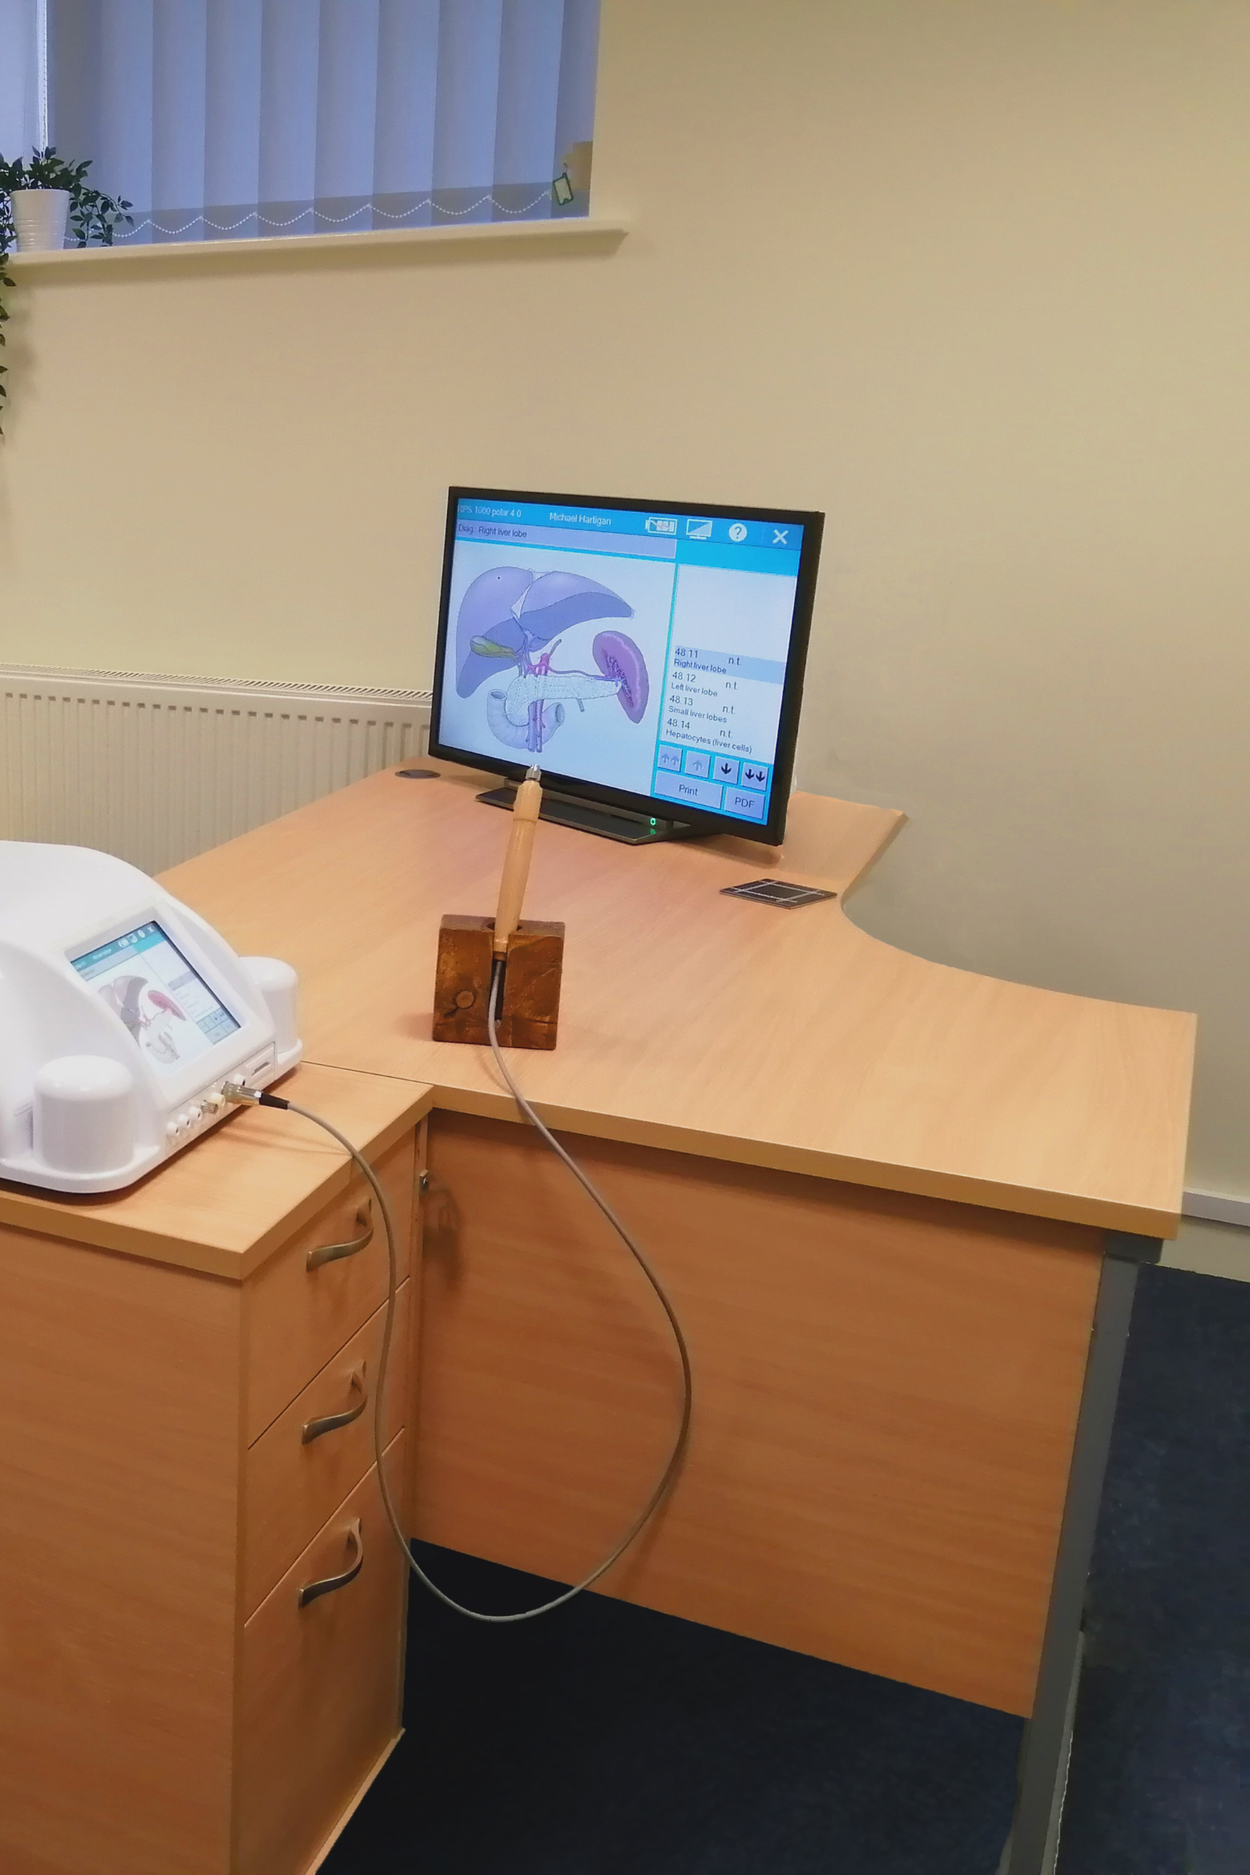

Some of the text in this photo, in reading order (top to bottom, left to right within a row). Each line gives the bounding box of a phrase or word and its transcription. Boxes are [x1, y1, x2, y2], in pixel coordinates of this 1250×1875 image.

[474, 506, 491, 516] 1000
[491, 508, 509, 517] polar
[549, 512, 612, 528] Michael Hartigan
[478, 526, 497, 537] Right
[497, 527, 511, 536] liver
[511, 528, 528, 538] lobe
[673, 658, 727, 674] Right liver lobe
[671, 682, 718, 698] Left liver lobe
[669, 695, 694, 706] 48.13
[668, 705, 728, 723] Small liver lobes
[666, 718, 691, 730] 48.14
[665, 728, 753, 754] Hepatocytes (liver cells)
[678, 783, 698, 797] Print
[734, 796, 756, 809] PDF
